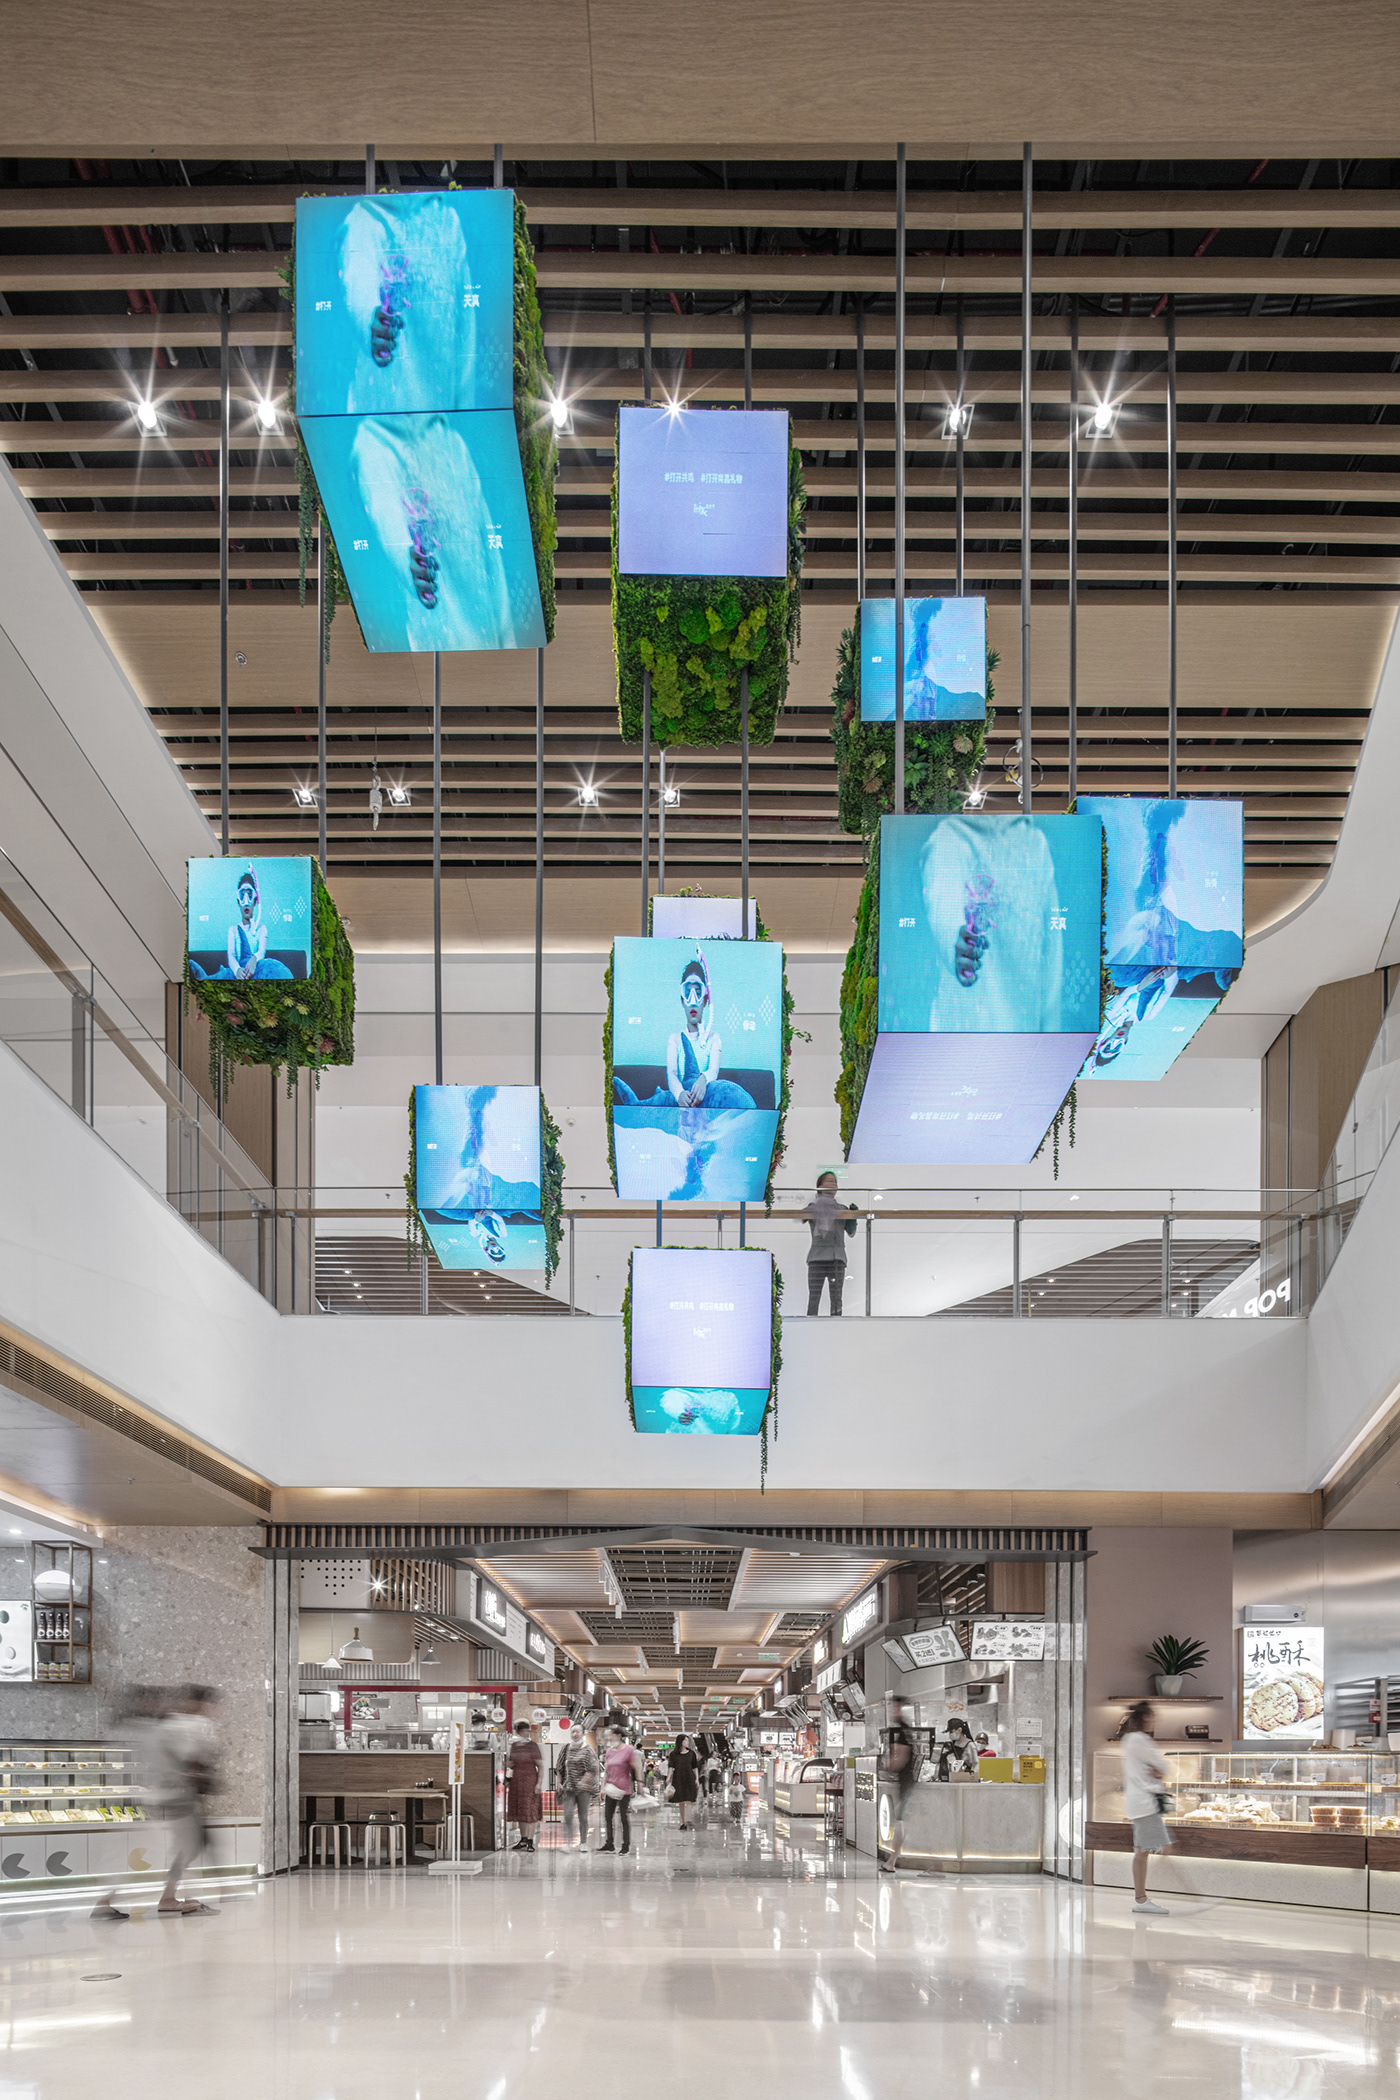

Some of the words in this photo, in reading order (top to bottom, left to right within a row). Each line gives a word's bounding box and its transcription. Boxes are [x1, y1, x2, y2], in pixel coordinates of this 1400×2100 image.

[463, 294, 480, 308] 天真
[487, 535, 504, 549] 天真
[1050, 917, 1067, 931] 天真
[1248, 1640, 1310, 1666] 桃酥
